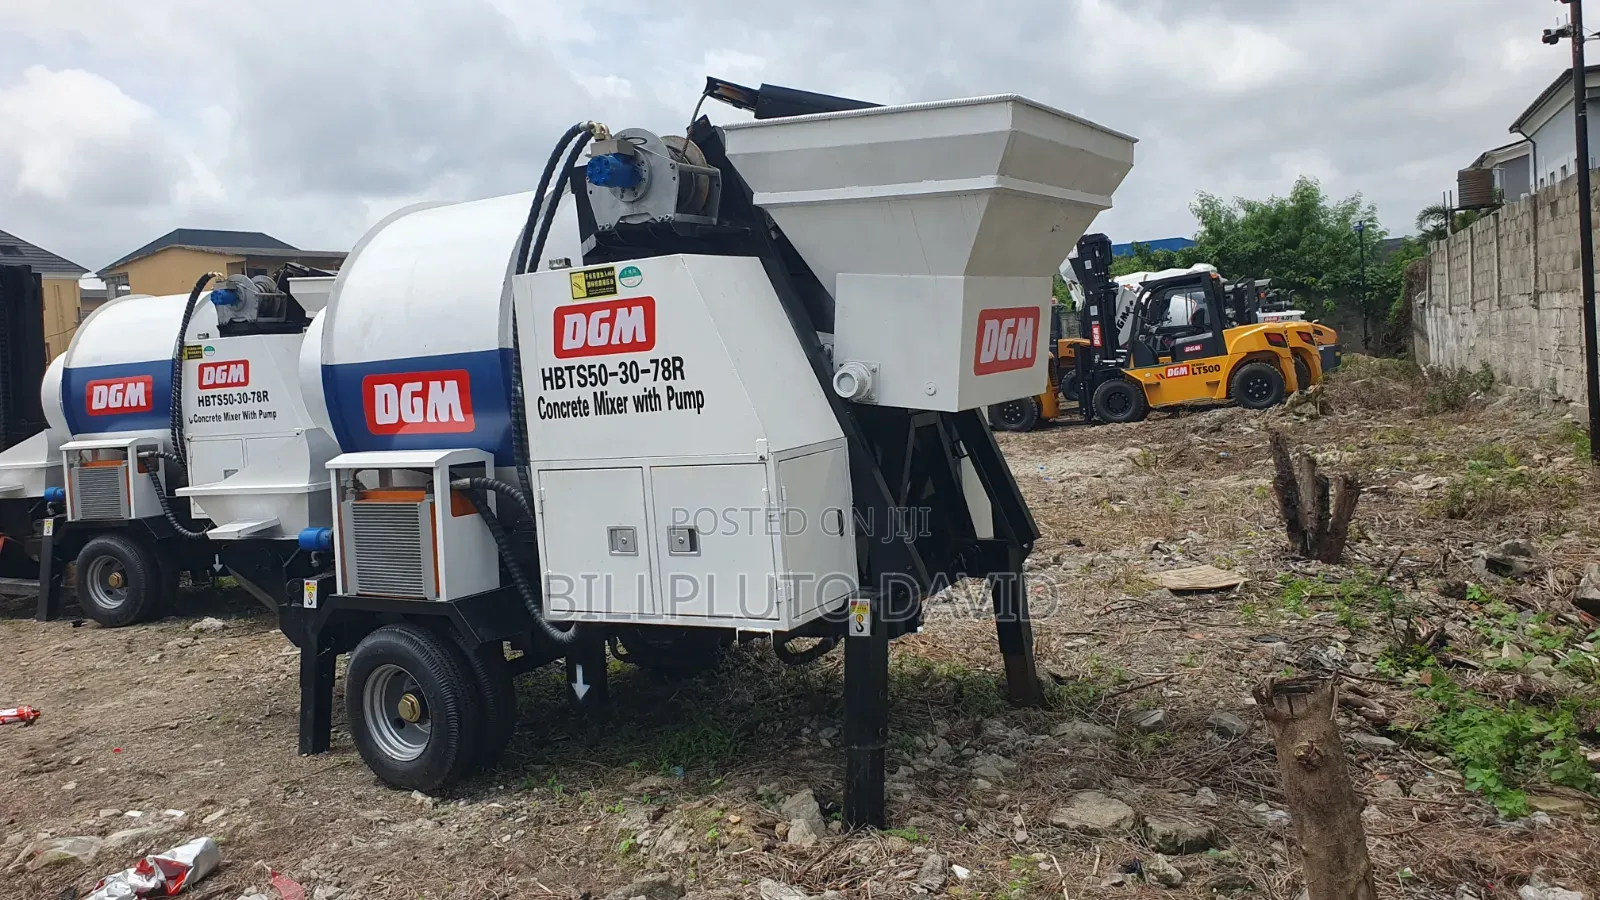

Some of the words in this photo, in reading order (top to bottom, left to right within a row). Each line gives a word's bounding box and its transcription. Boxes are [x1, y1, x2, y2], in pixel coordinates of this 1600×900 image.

[562, 306, 646, 351] DGM
[980, 317, 1034, 364] DGM
[202, 364, 245, 386] DGM
[541, 356, 685, 391] HBTS50-30-78R
[1167, 366, 1188, 377] DGM
[1191, 364, 1221, 376] LT500
[92, 382, 147, 410] DGM
[197, 391, 270, 408] HBTS50-30-78R
[374, 380, 465, 426] DGM
[537, 395, 590, 420] Concrete
[593, 391, 628, 416] Mixer
[632, 388, 664, 412] with
[666, 386, 705, 414] Pump
[193, 412, 221, 424] Concrete
[223, 411, 241, 422] Mixer
[242, 410, 257, 420] With
[259, 409, 277, 421] Pump
